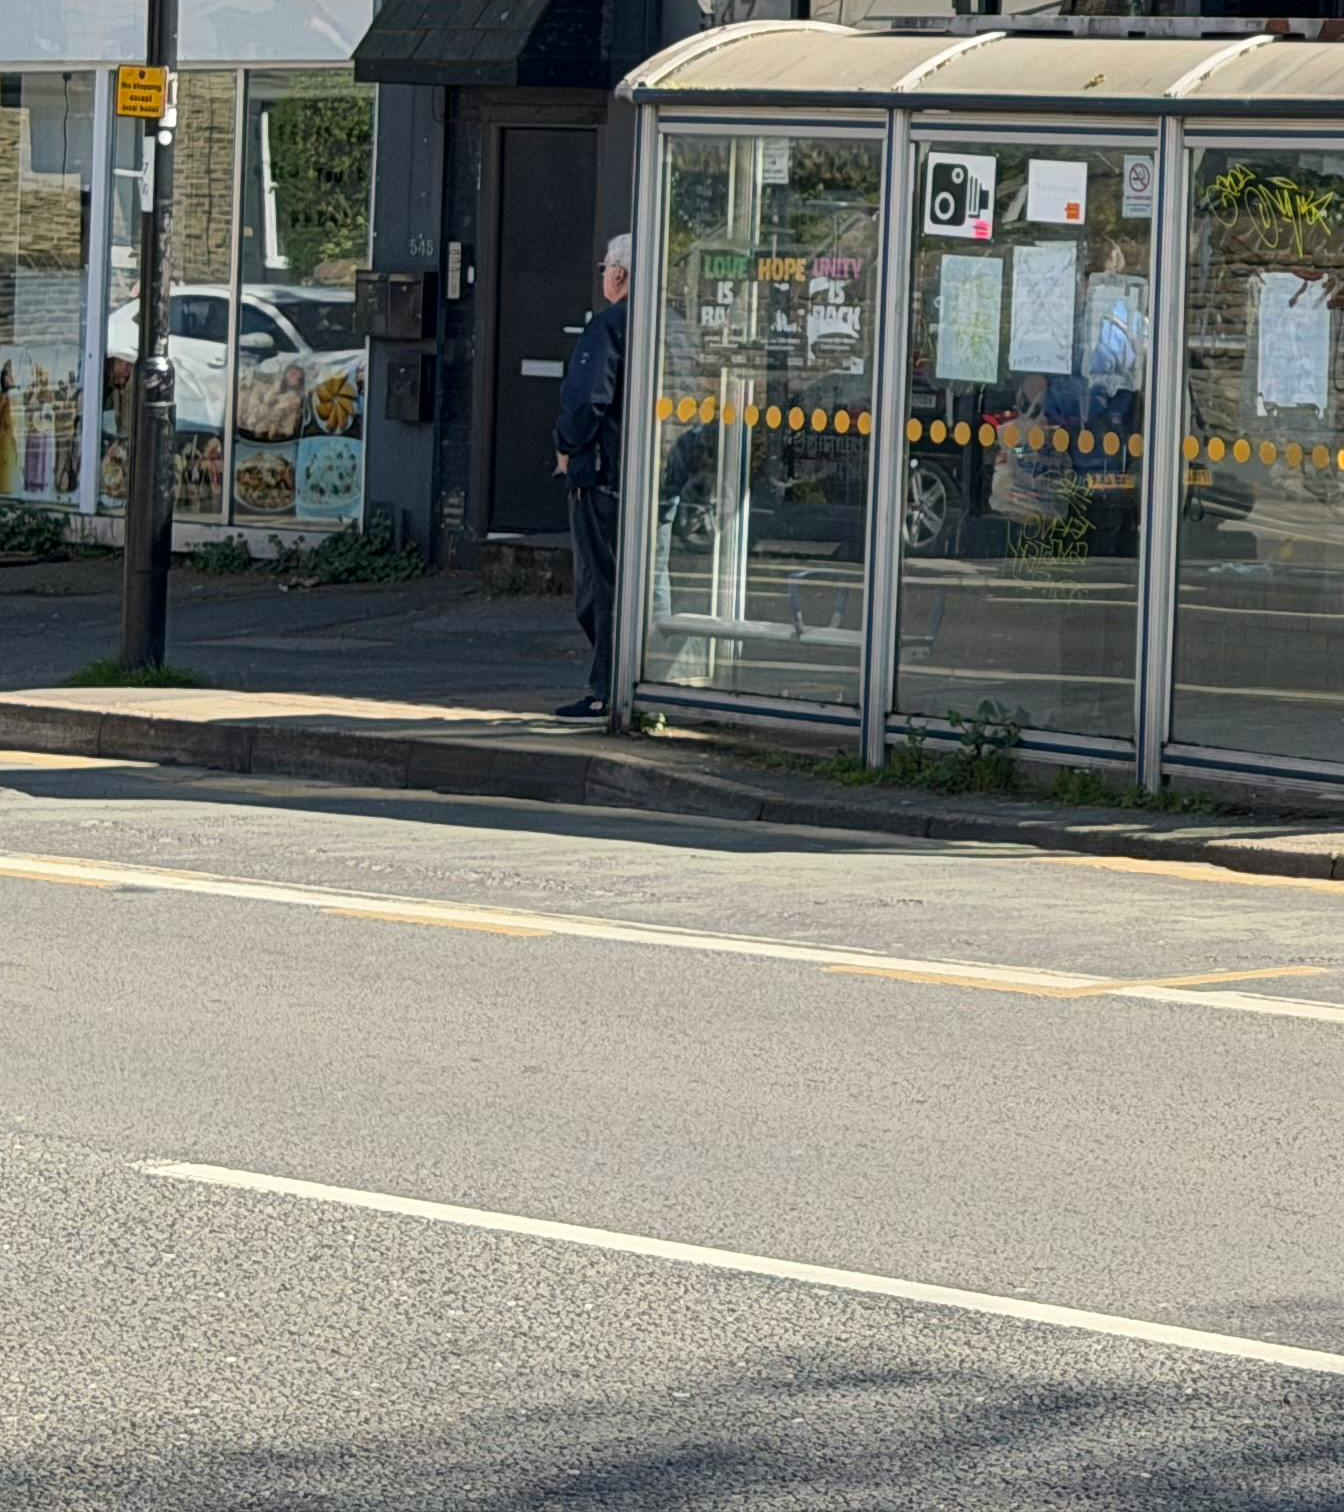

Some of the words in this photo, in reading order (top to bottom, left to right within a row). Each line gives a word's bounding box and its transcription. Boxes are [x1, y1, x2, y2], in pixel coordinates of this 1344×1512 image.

[704, 255, 749, 280] LOVE
[758, 258, 807, 281] HOPE
[811, 257, 864, 280] UNITY
[716, 281, 735, 305] IS
